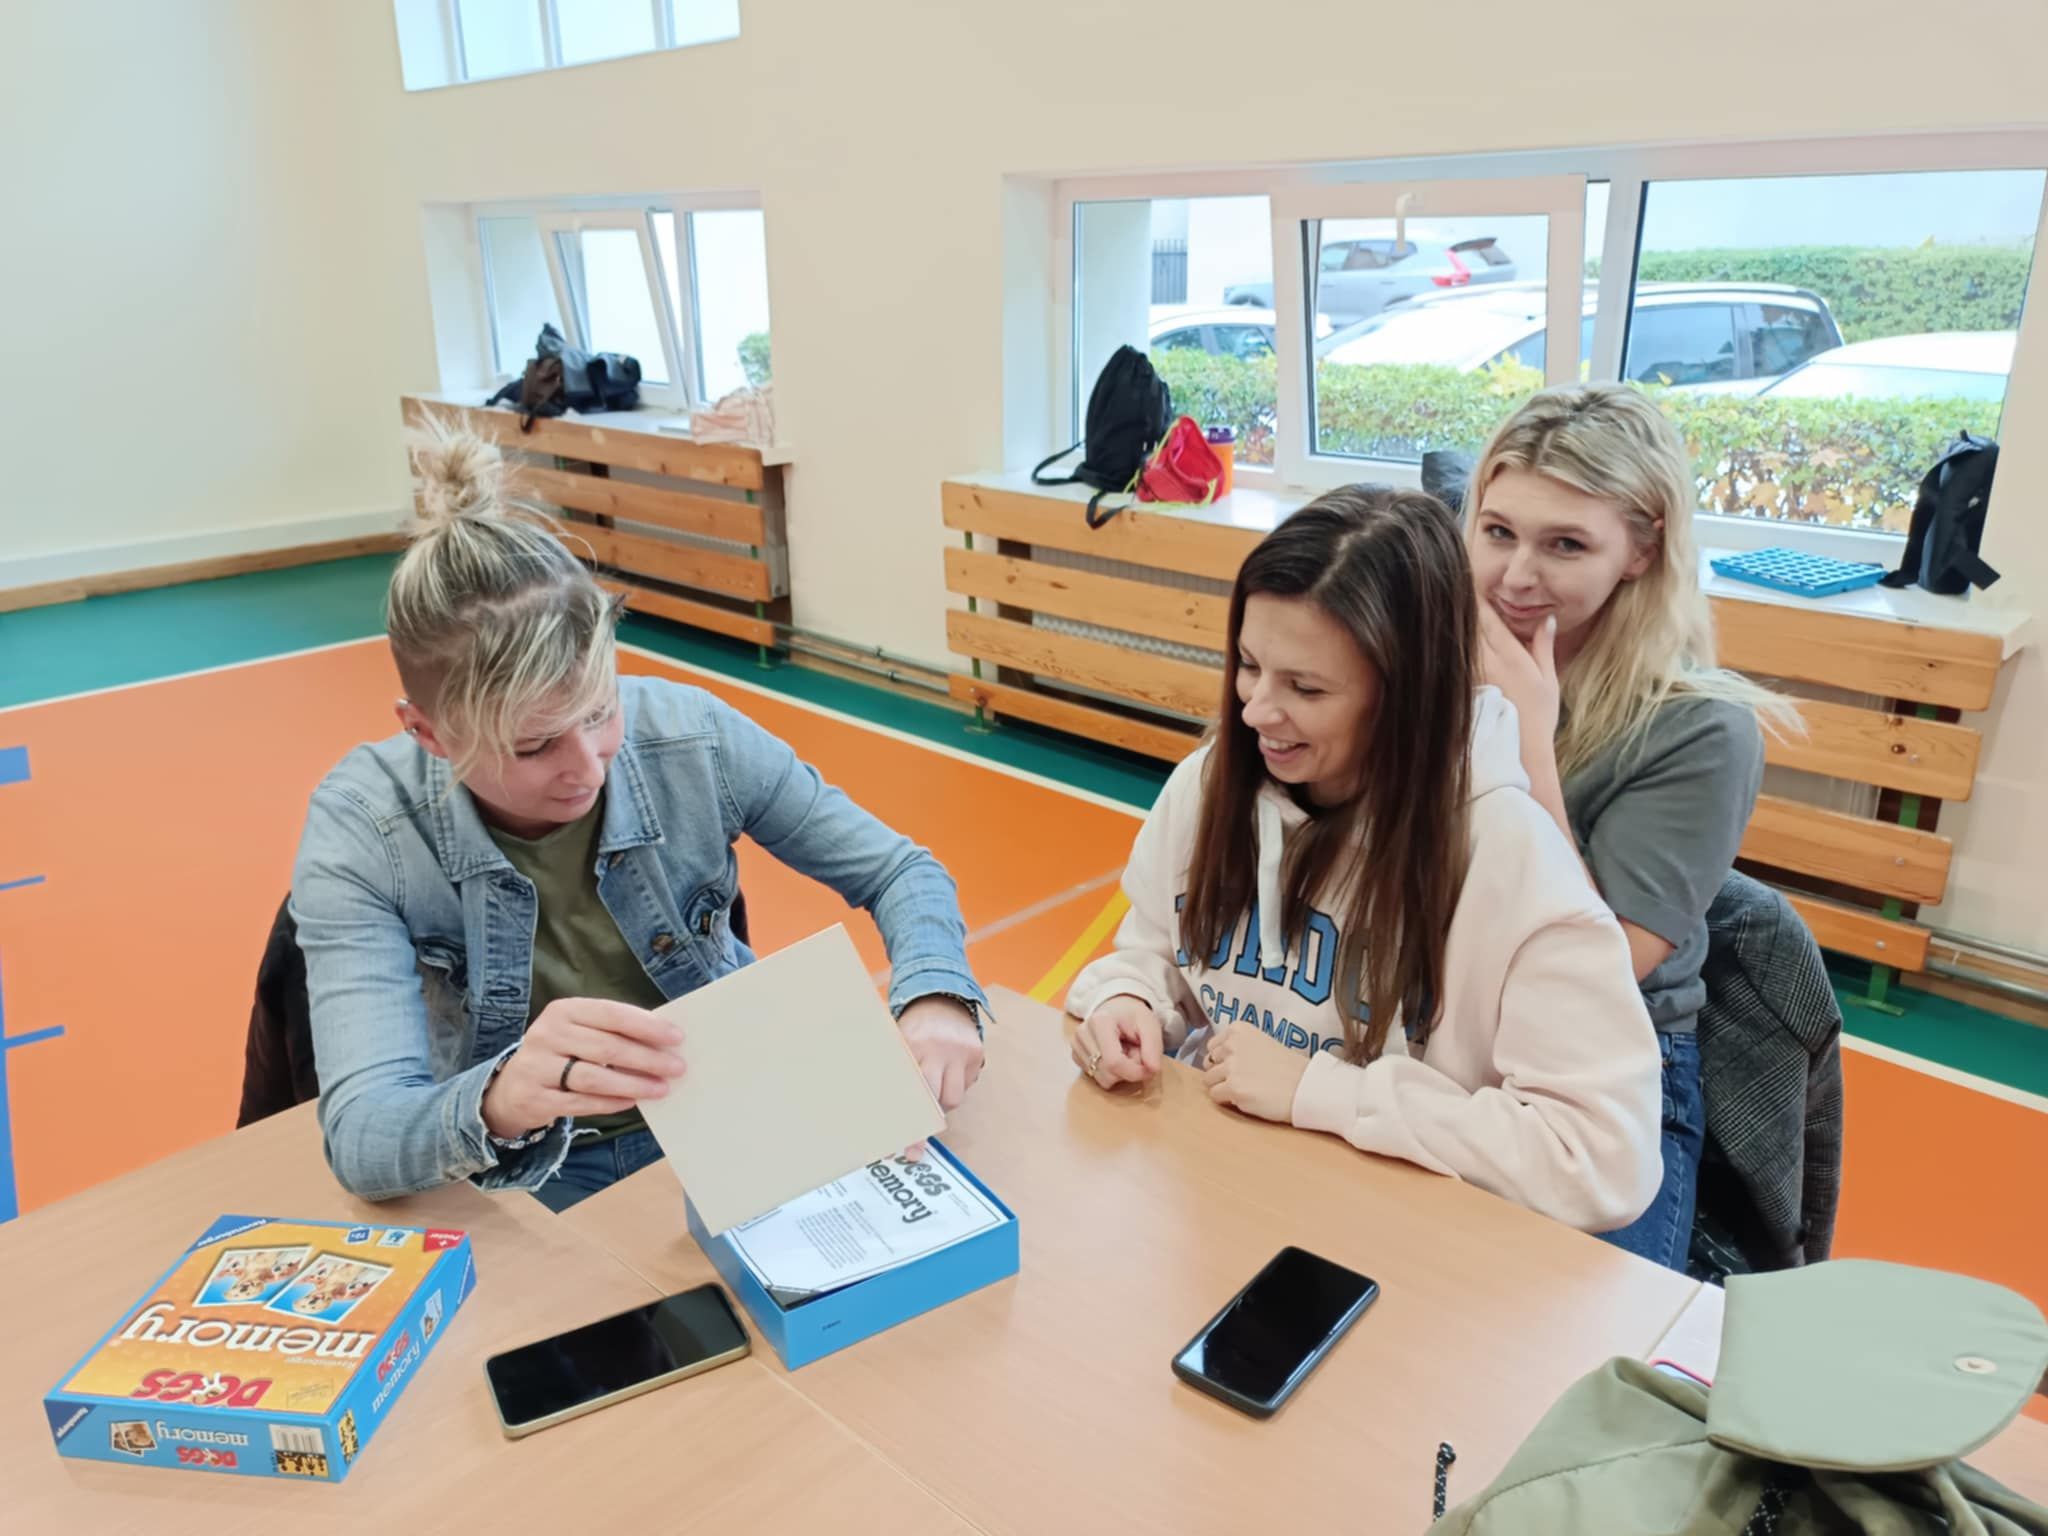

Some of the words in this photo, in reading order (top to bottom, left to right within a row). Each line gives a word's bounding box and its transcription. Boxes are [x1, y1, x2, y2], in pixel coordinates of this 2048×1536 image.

[119, 1303, 376, 1357] memory
[130, 1369, 273, 1408] DOGS
[372, 1339, 421, 1414] memory
[156, 1420, 249, 1446] memory
[176, 1445, 239, 1467] DOGS
